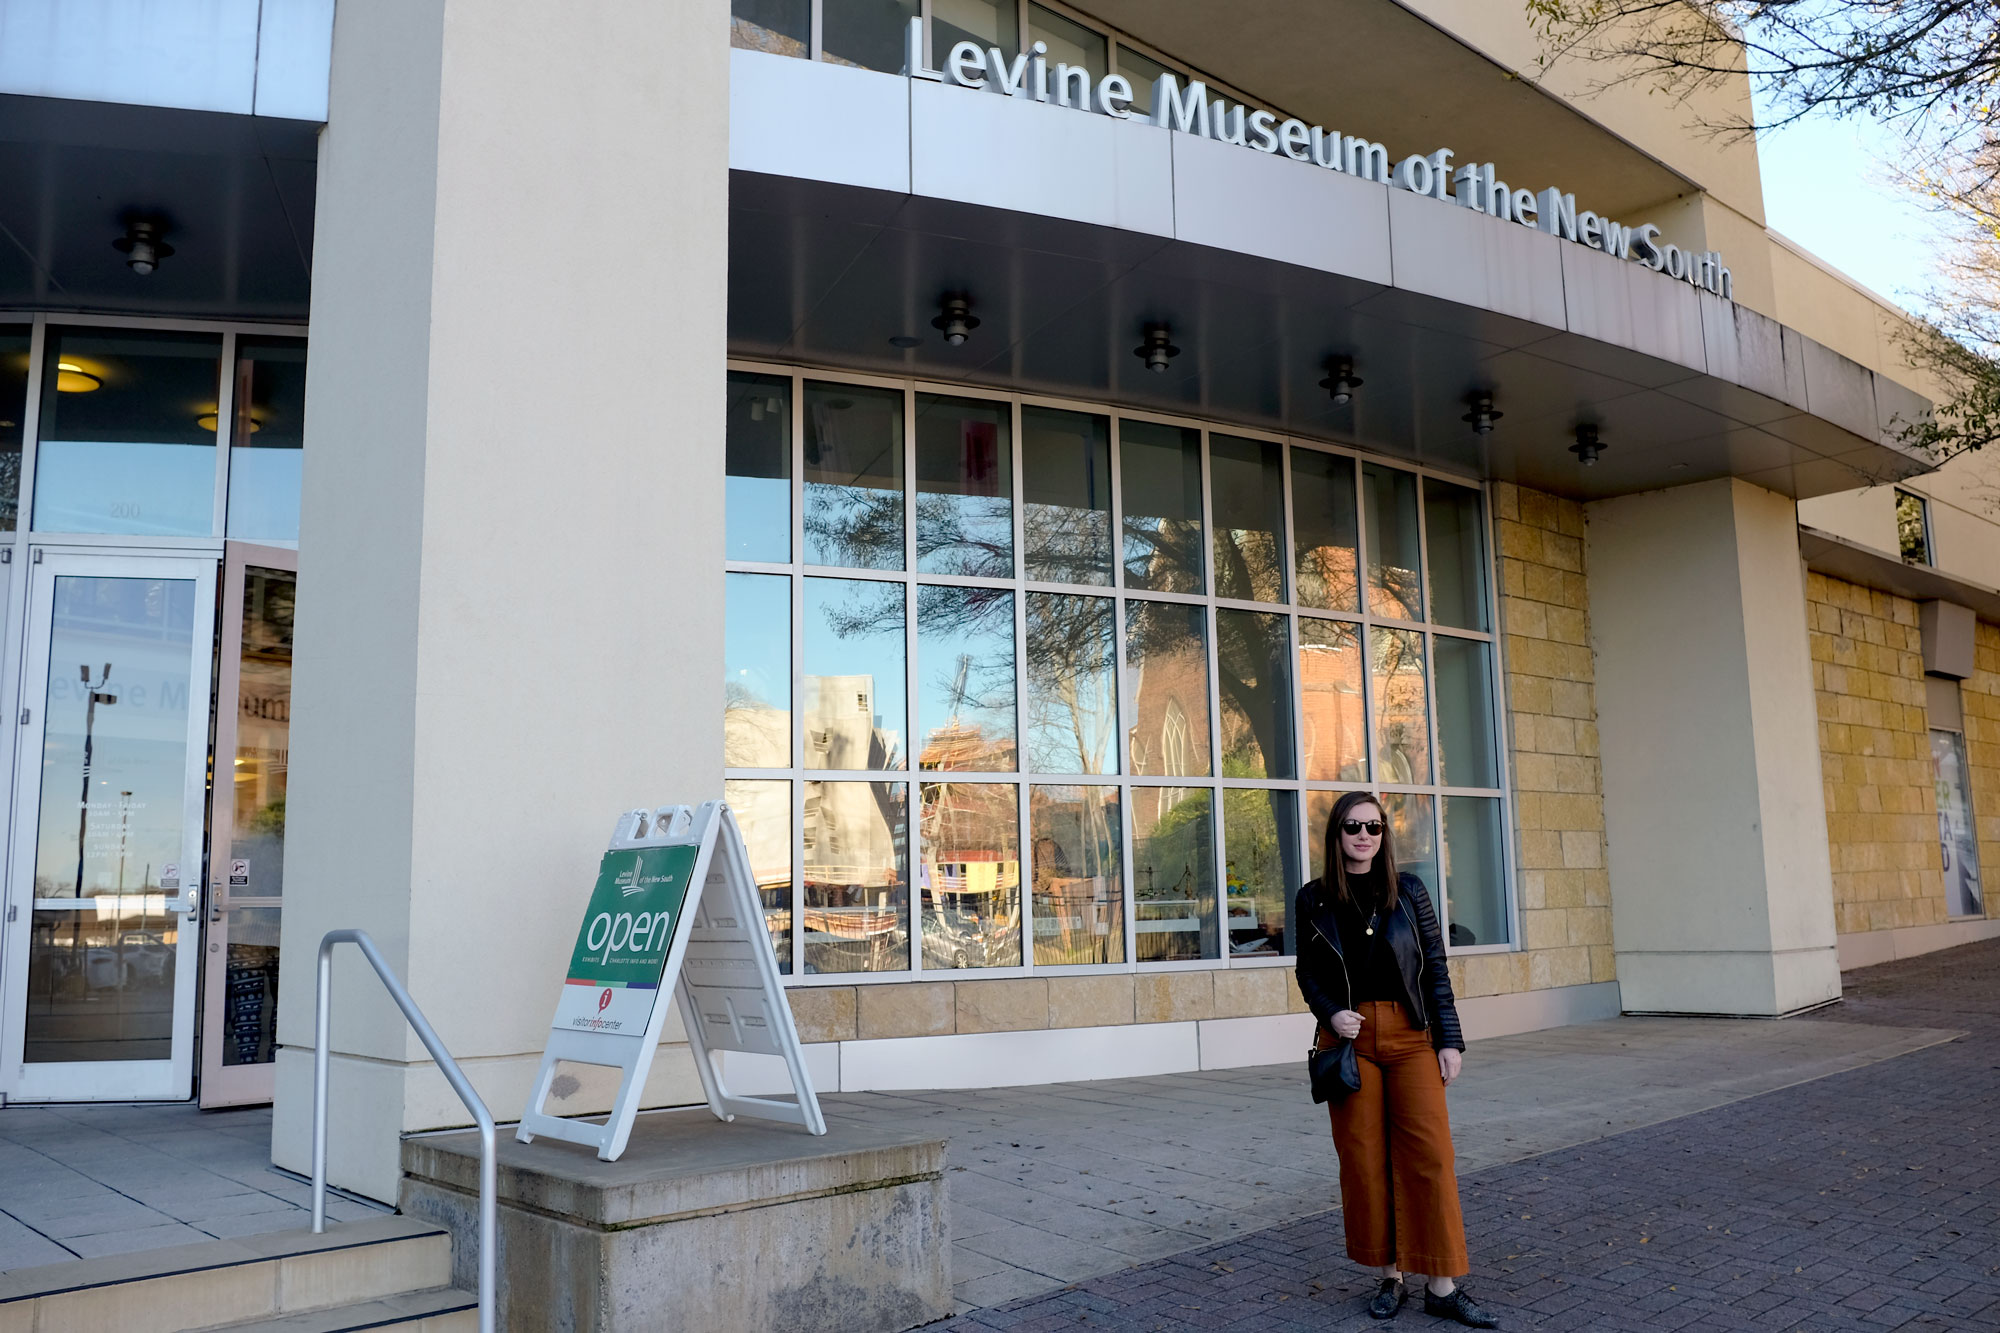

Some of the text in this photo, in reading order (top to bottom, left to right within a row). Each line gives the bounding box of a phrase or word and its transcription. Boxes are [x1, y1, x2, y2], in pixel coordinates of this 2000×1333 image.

[907, 16, 1733, 300] Levine Museum of the New South
[111, 502, 141, 519] 200
[587, 911, 670, 966] open
[572, 1016, 622, 1030] visitorinfocenter
